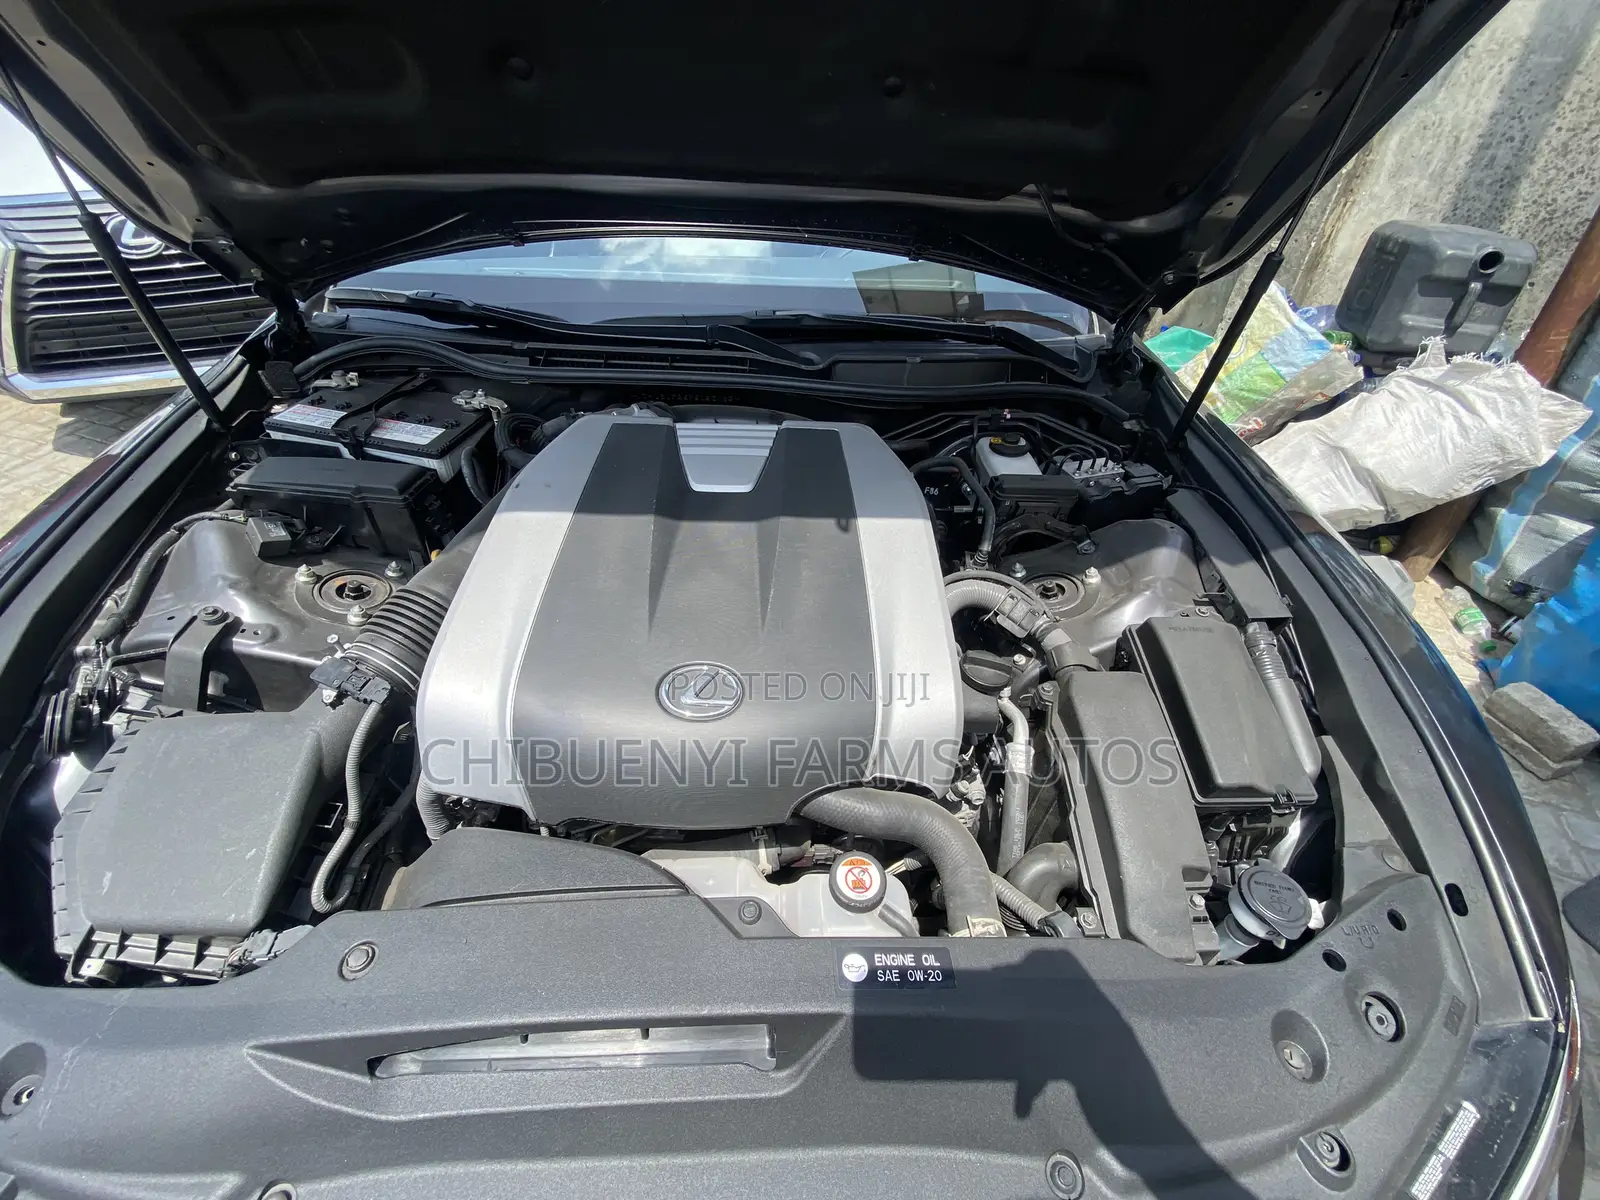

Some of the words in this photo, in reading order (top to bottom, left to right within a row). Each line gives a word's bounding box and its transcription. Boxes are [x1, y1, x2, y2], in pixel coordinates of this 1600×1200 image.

[874, 953, 916, 966] ENGINE
[922, 953, 941, 966] OIL
[877, 969, 901, 982] SAE
